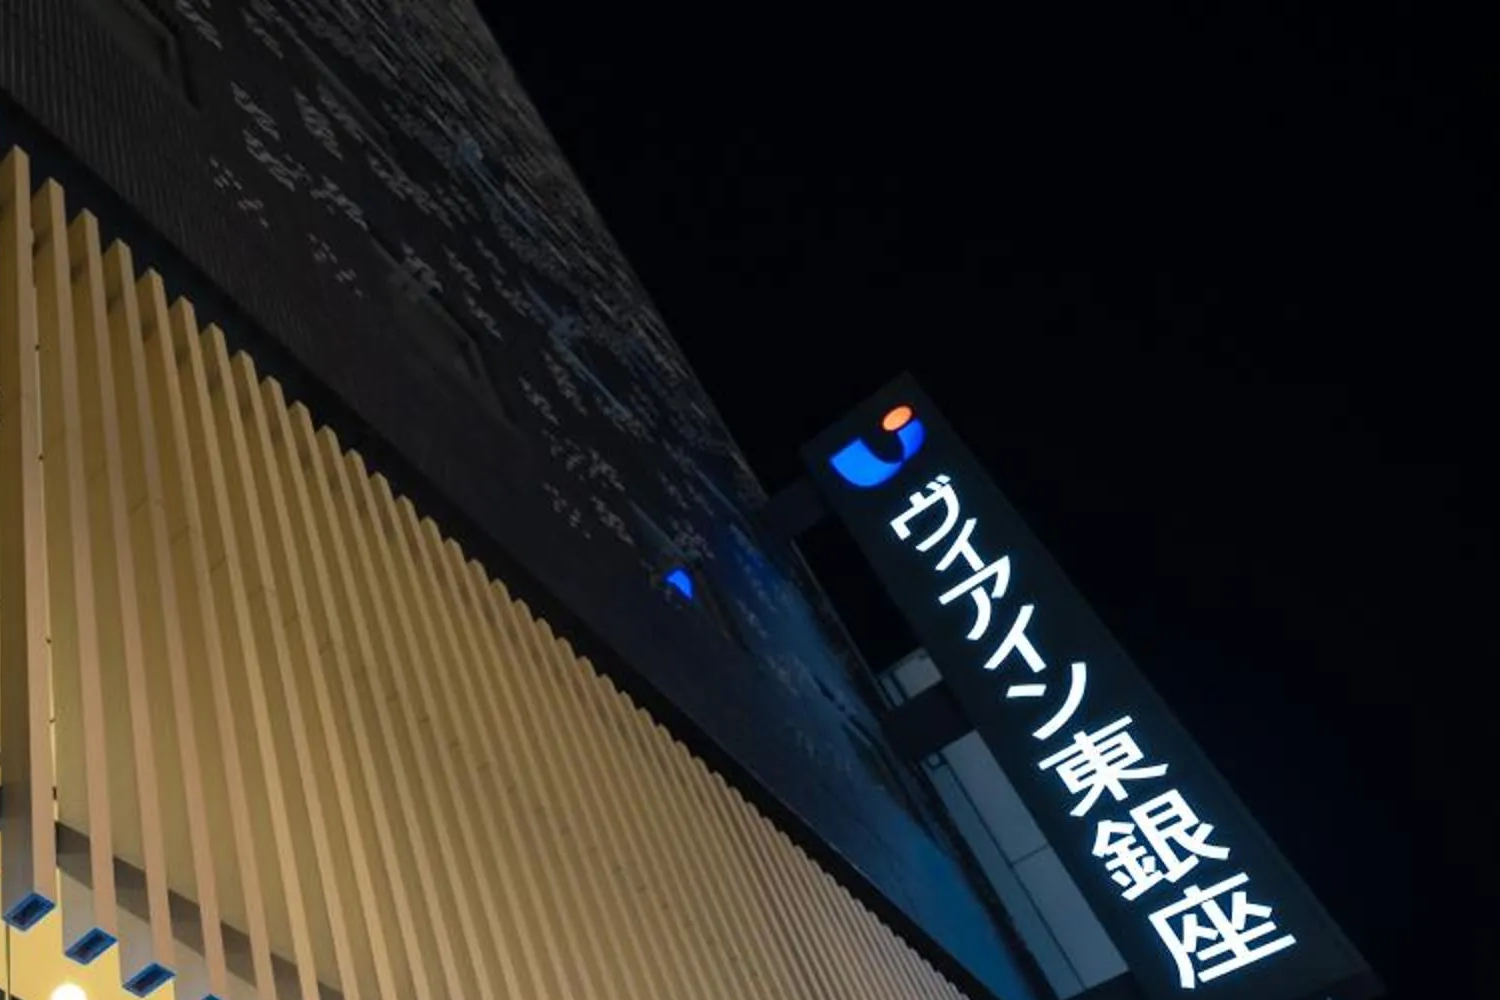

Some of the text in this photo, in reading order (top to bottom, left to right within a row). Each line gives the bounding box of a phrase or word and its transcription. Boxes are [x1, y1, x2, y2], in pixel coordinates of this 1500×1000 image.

[889, 474, 1297, 989] ヴィアイン東銀座
